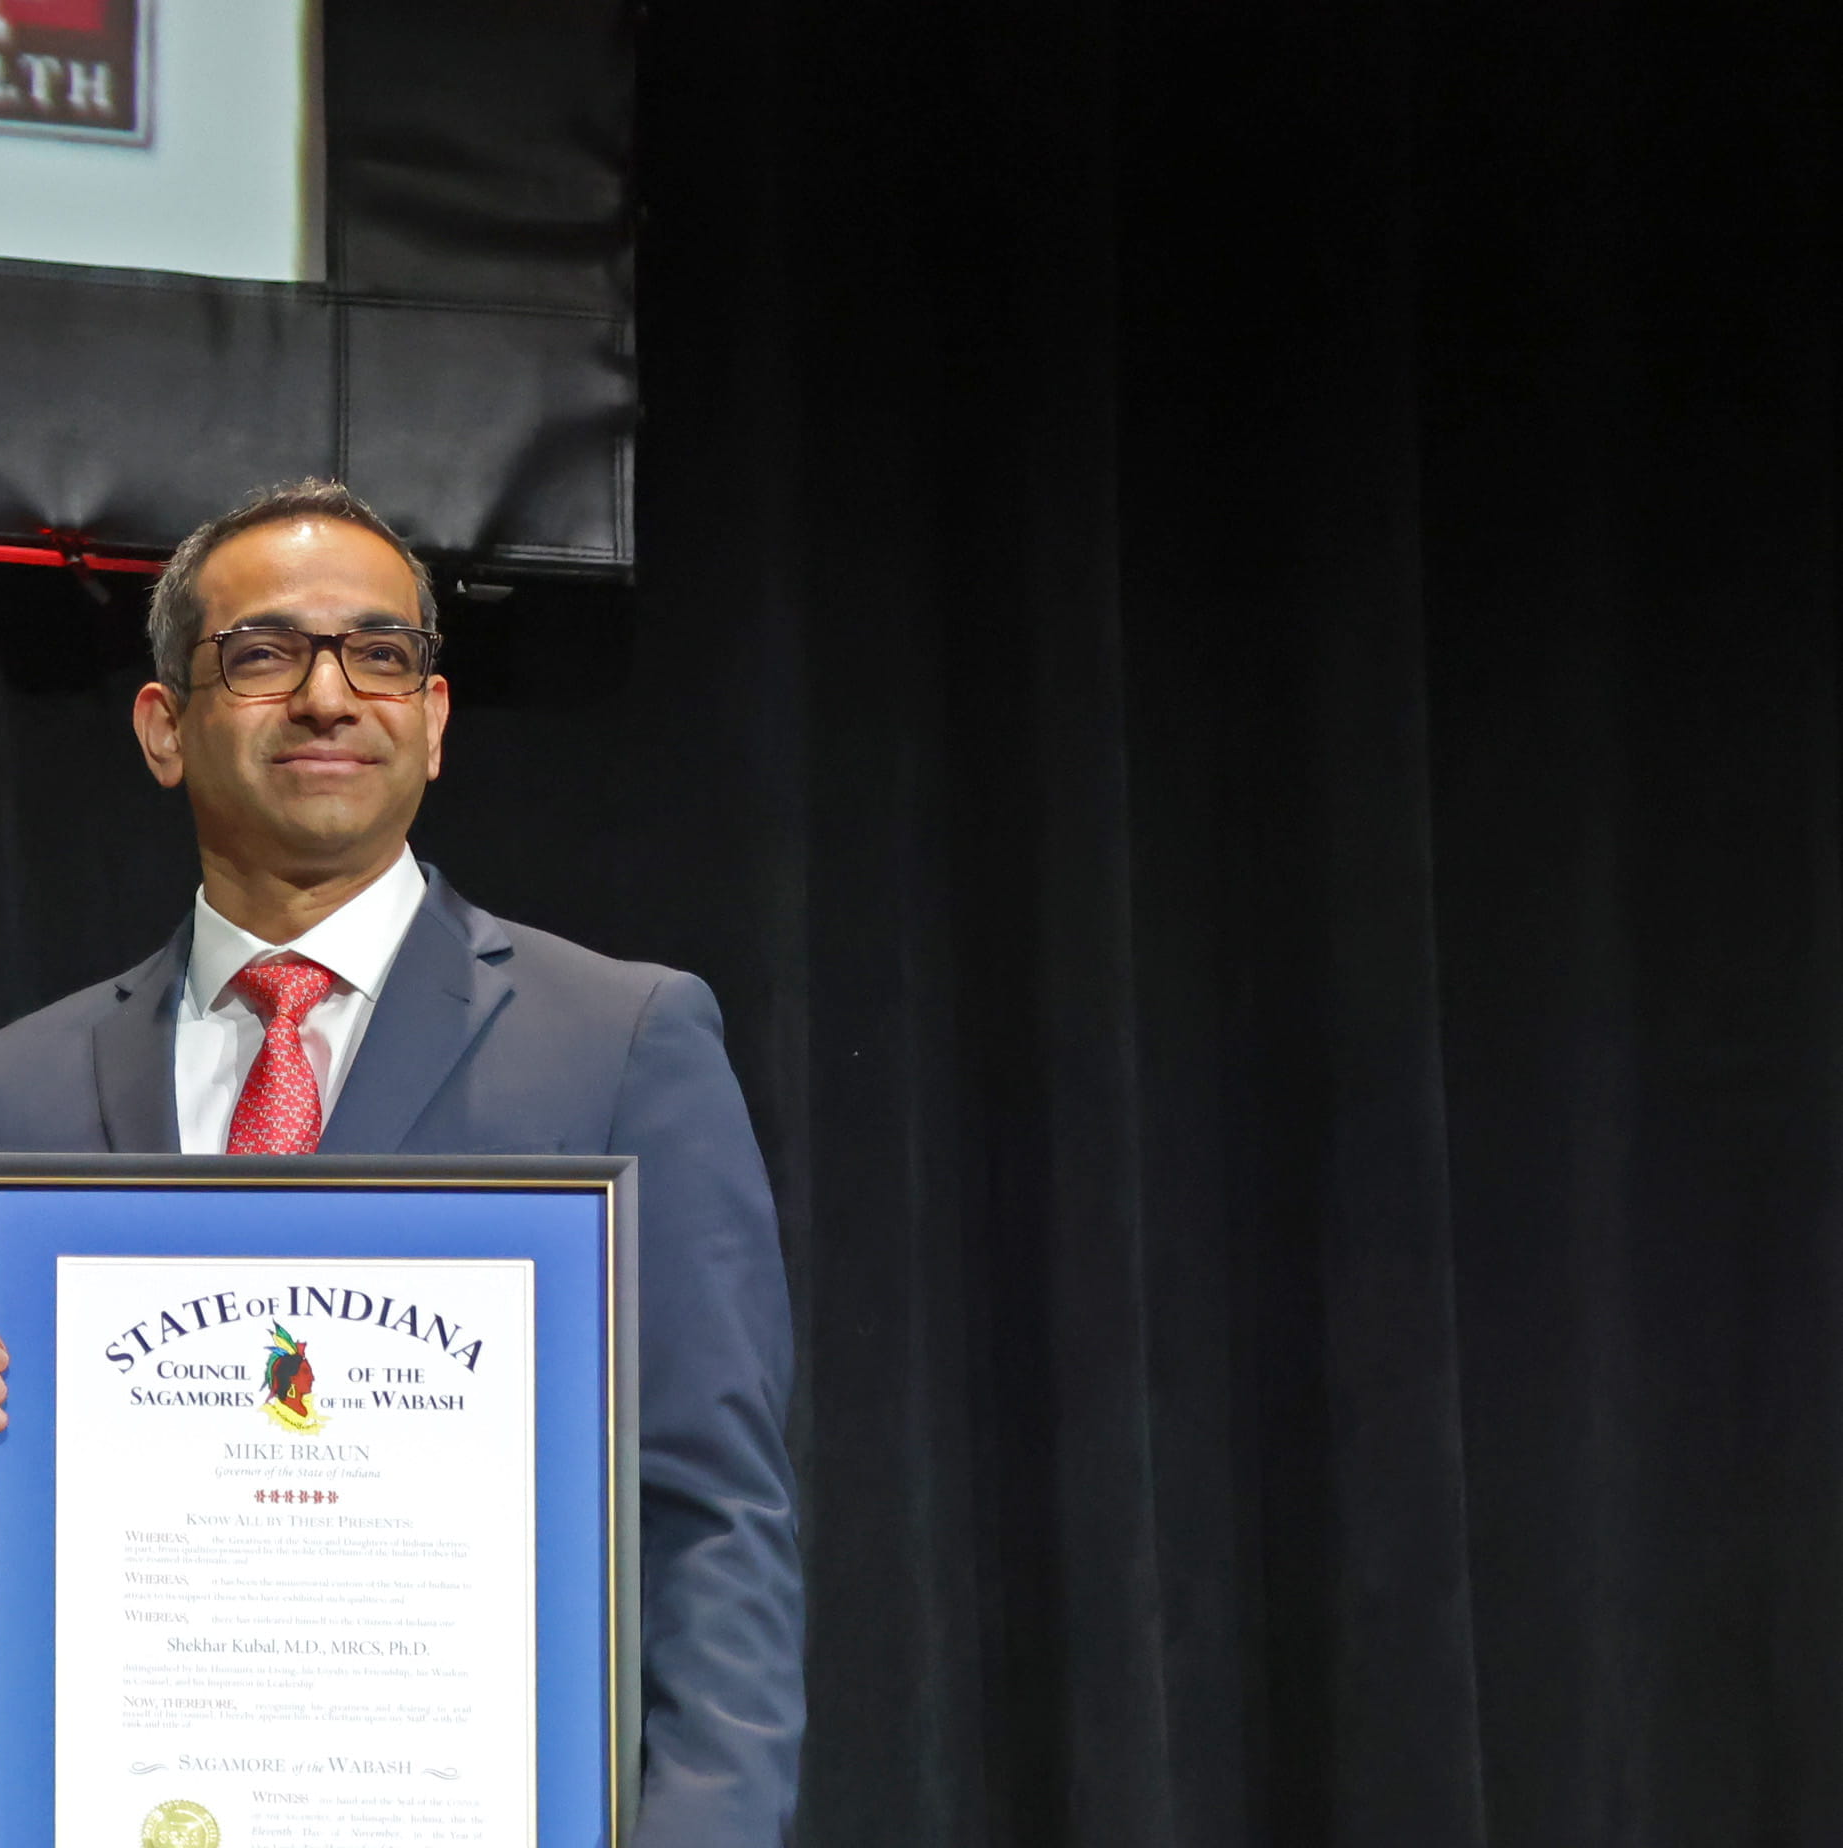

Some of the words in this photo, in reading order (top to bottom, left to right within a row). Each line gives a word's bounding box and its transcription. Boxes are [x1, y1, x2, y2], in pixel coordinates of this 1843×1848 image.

[105, 1291, 241, 1374] STATE
[246, 1297, 281, 1318] OF
[287, 1286, 484, 1373] INDIANA
[156, 1360, 251, 1381] COUNCIL
[348, 1368, 376, 1384] OF
[382, 1368, 425, 1385] THE
[130, 1387, 254, 1408] SAGAMORES
[320, 1397, 337, 1409] OF
[340, 1397, 366, 1410] THE
[372, 1390, 465, 1411] WABASH
[224, 1442, 283, 1460] MIKE
[291, 1444, 369, 1461] BRAUN
[186, 1512, 229, 1525] KNOW
[166, 1636, 227, 1653] Shekhar
[232, 1638, 279, 1655] Kubal,
[178, 1754, 285, 1772] SAGAMORE
[328, 1756, 411, 1775] WABASH
